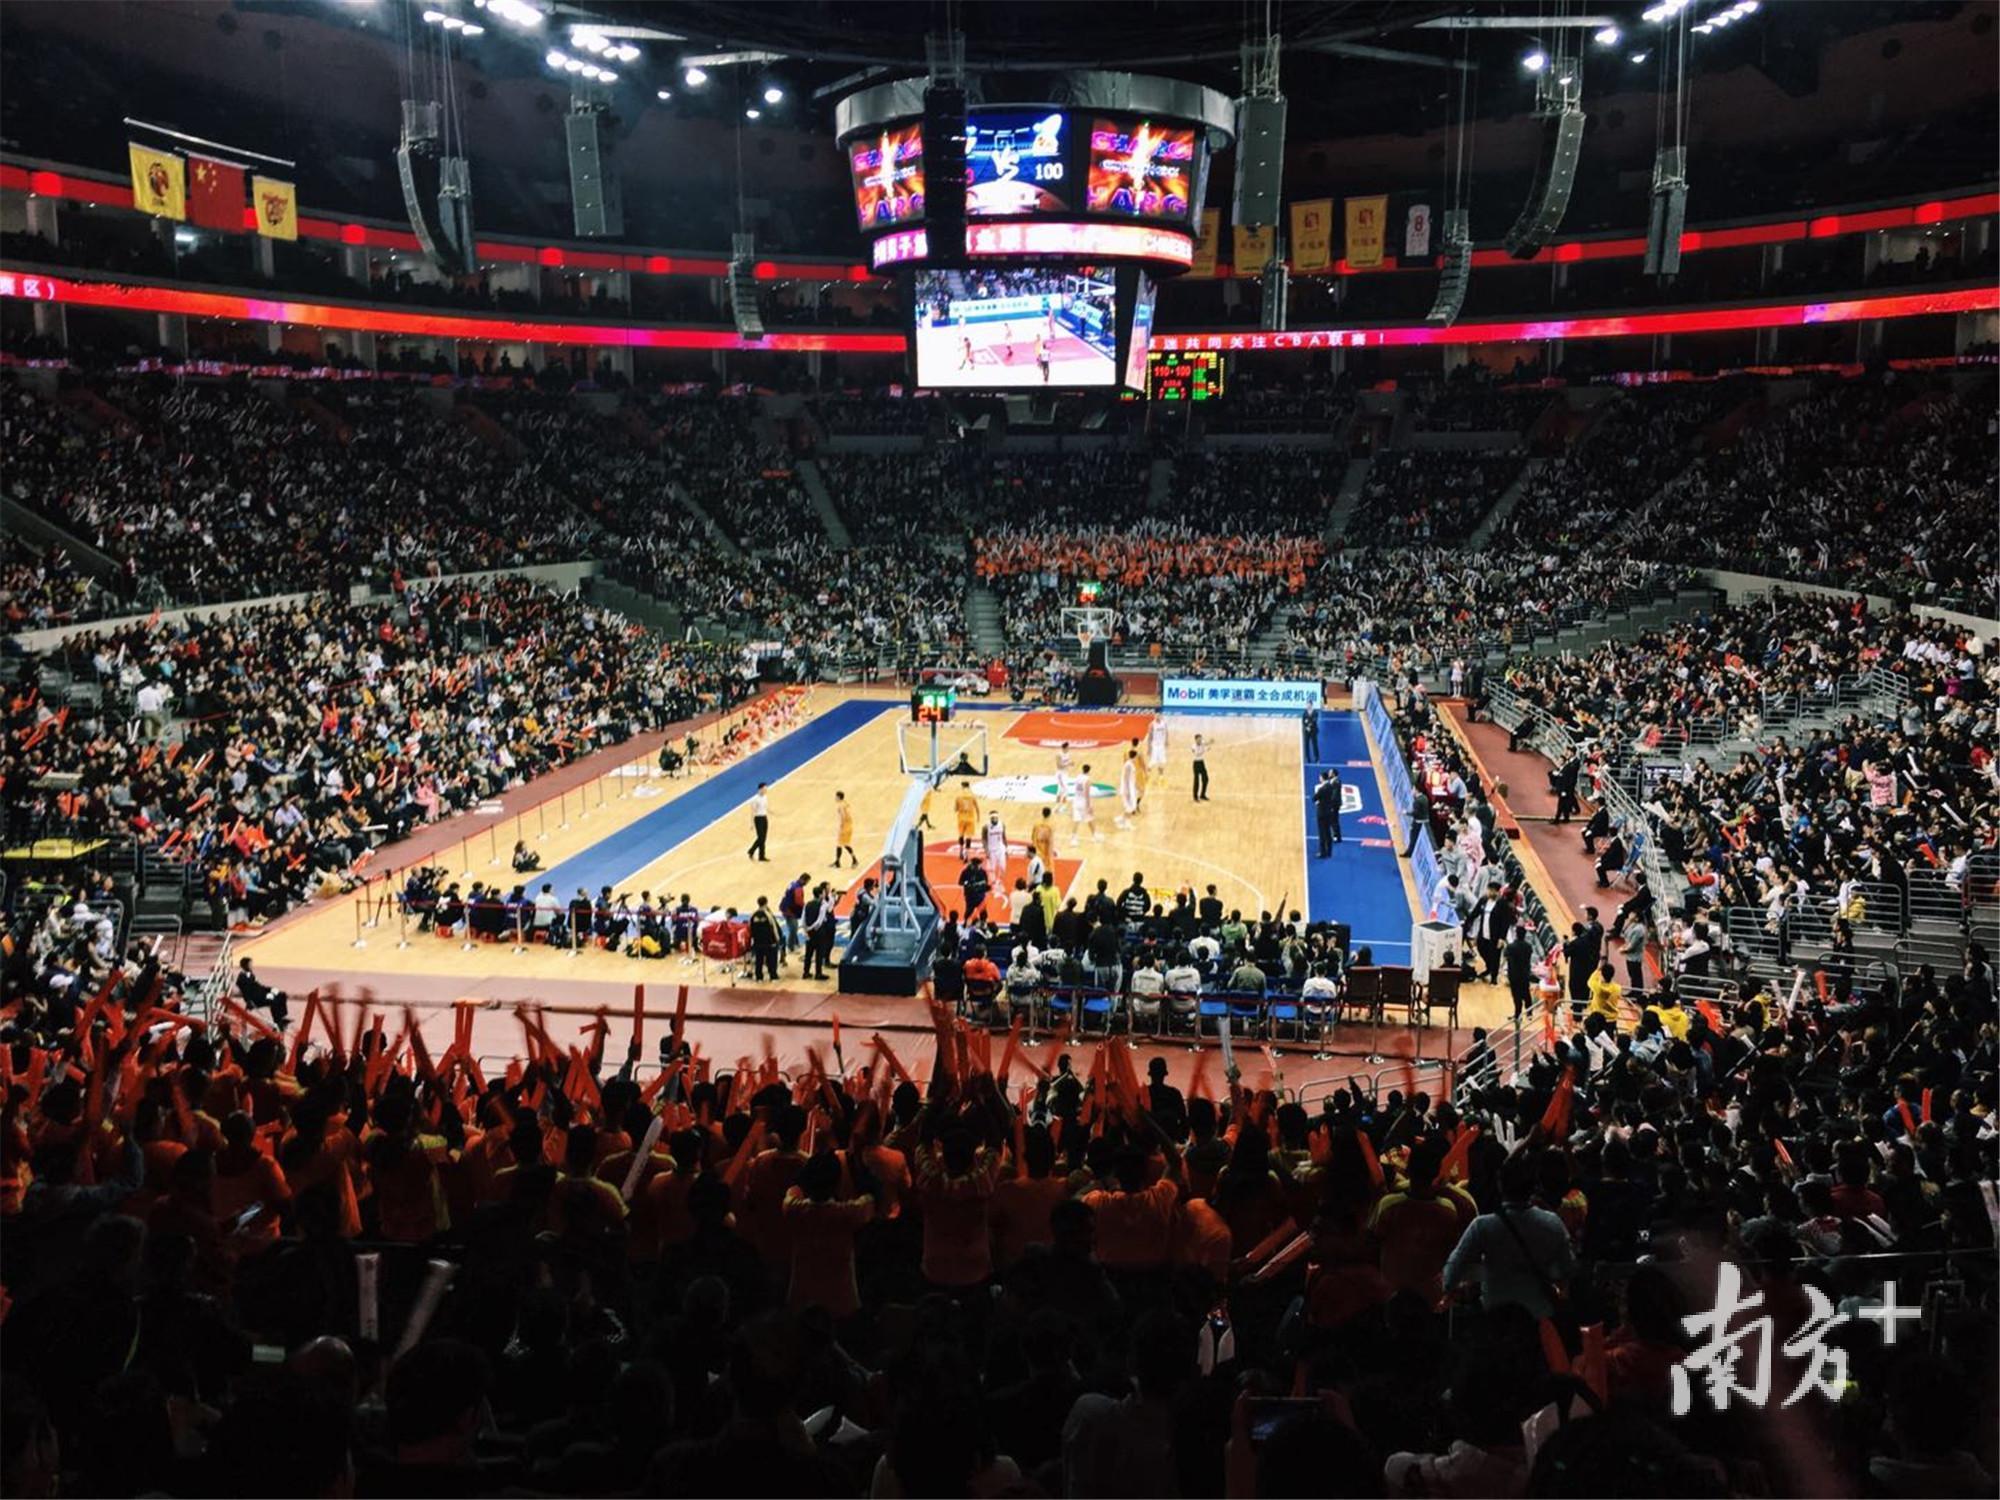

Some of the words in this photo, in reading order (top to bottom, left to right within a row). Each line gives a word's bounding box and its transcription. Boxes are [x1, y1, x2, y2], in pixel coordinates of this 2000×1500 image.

[1035, 162, 1064, 180] 100
[1414, 215, 1424, 232] 8
[1167, 686, 1205, 700] Mobil
[1258, 689, 1318, 702] 全合成机油
[918, 704, 941, 721] 24
